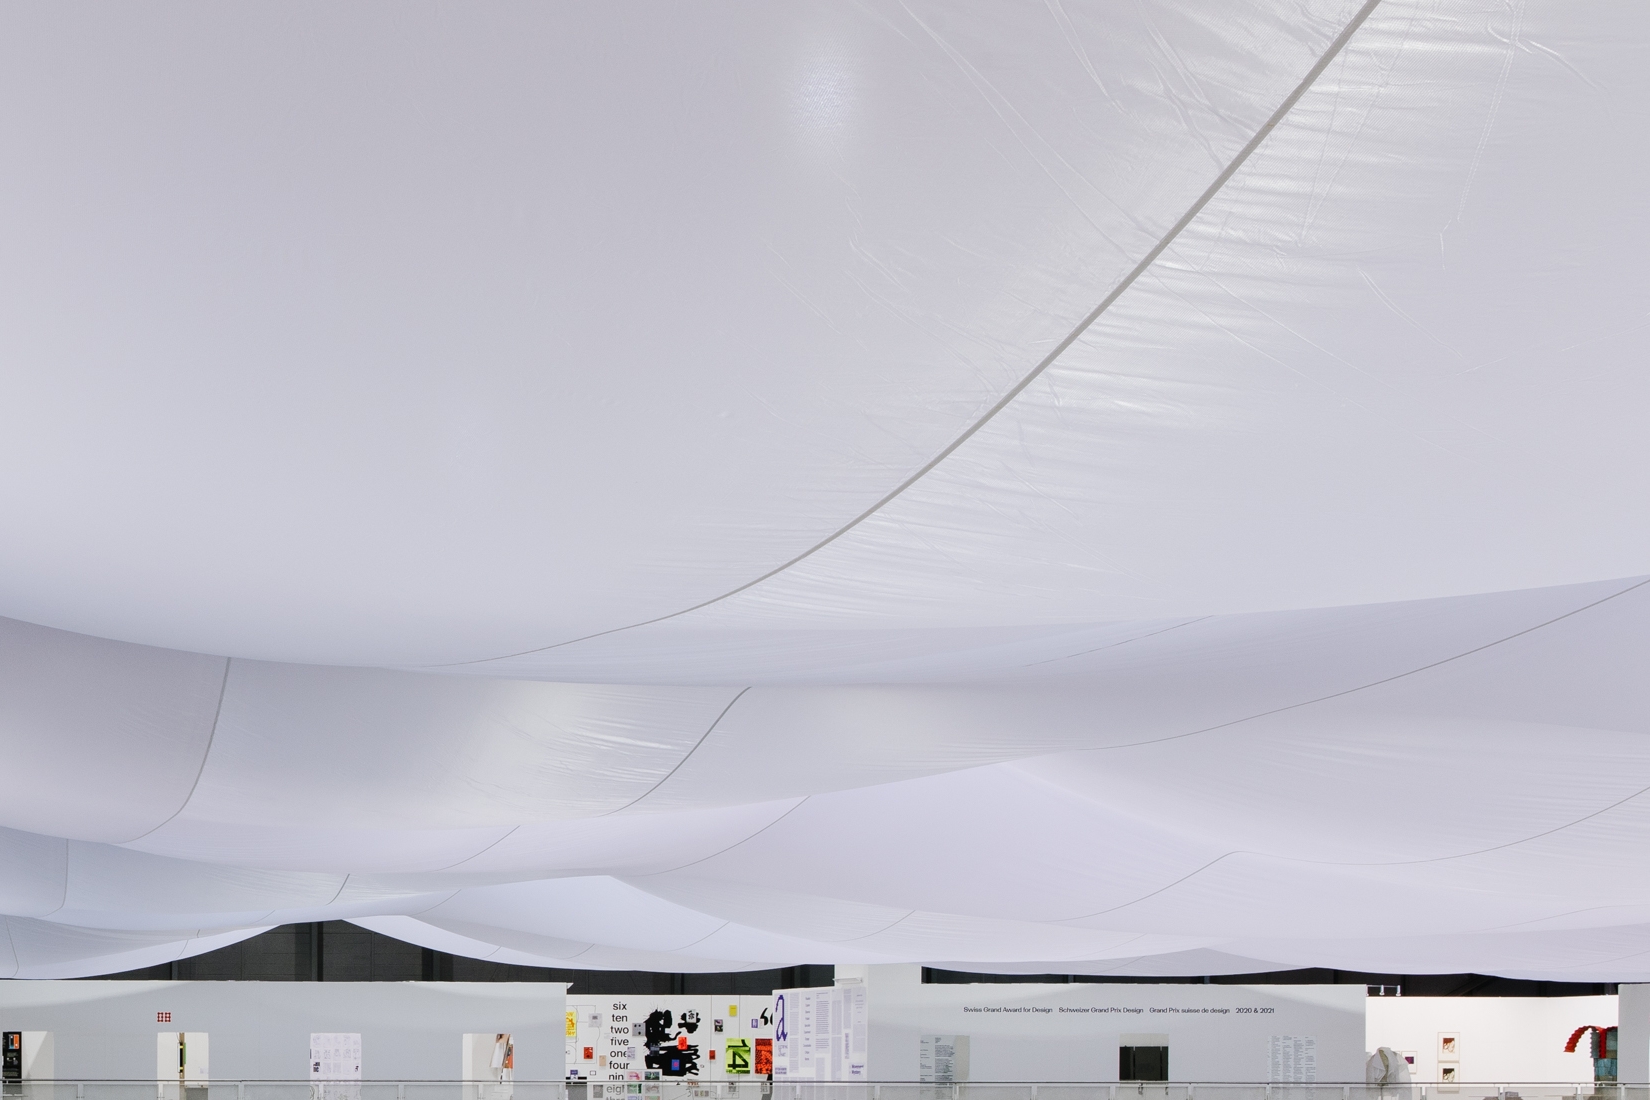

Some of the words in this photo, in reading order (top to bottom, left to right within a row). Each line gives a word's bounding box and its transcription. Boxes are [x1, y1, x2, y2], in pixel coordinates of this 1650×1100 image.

[612, 1001, 628, 1011] six
[1032, 1006, 1053, 1015] Design
[1059, 1006, 1089, 1014] Schweizer
[1123, 1007, 1144, 1015] Design
[1210, 1007, 1230, 1015] design
[612, 1014, 628, 1023] ten
[610, 1026, 629, 1035] two
[610, 1038, 629, 1046] five
[609, 1061, 630, 1070] four
[608, 1072, 625, 1081] nin
